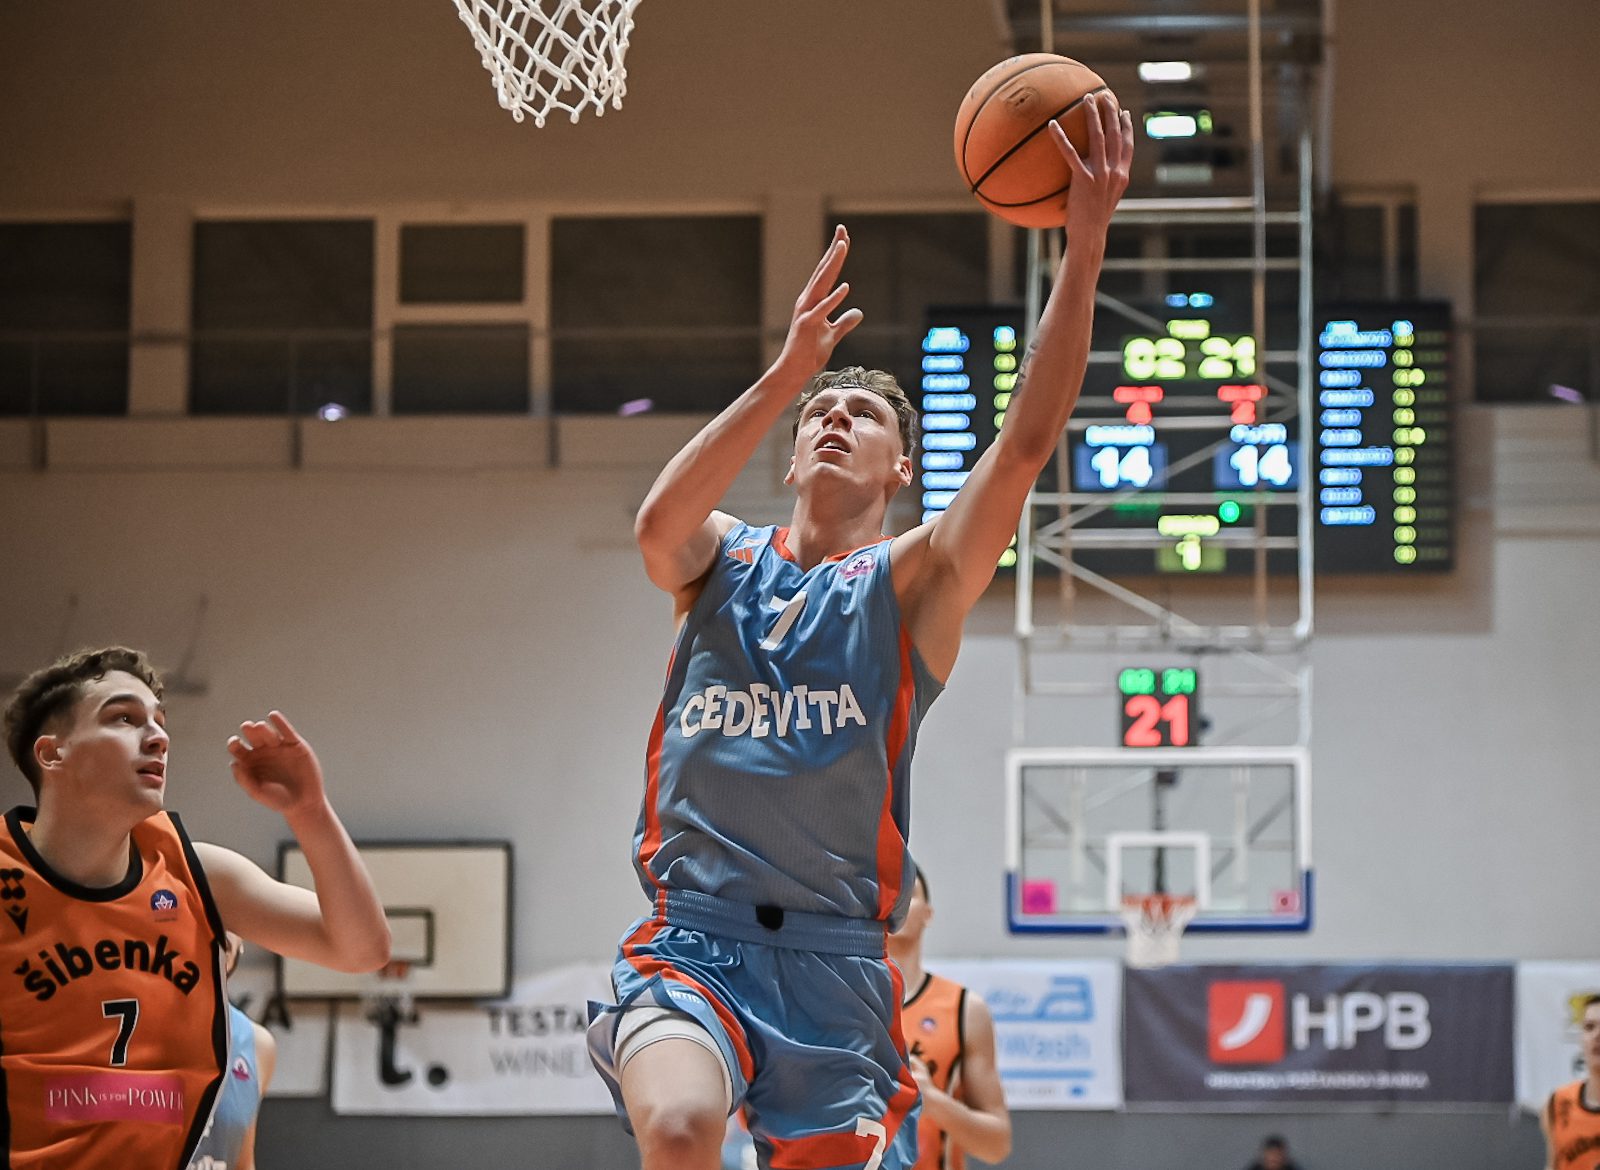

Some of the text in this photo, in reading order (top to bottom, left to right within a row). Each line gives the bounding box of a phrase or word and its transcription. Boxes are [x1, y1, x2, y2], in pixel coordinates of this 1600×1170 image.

[1091, 446, 1152, 488] 14
[1229, 445, 1292, 486] 14
[758, 590, 808, 651] 7
[680, 683, 867, 738] CEDEVITA
[1124, 694, 1189, 746] 21
[14, 935, 200, 1002] šibenka
[101, 998, 139, 1066] 7
[1292, 991, 1432, 1050] HPB
[855, 1116, 887, 1170] 7
